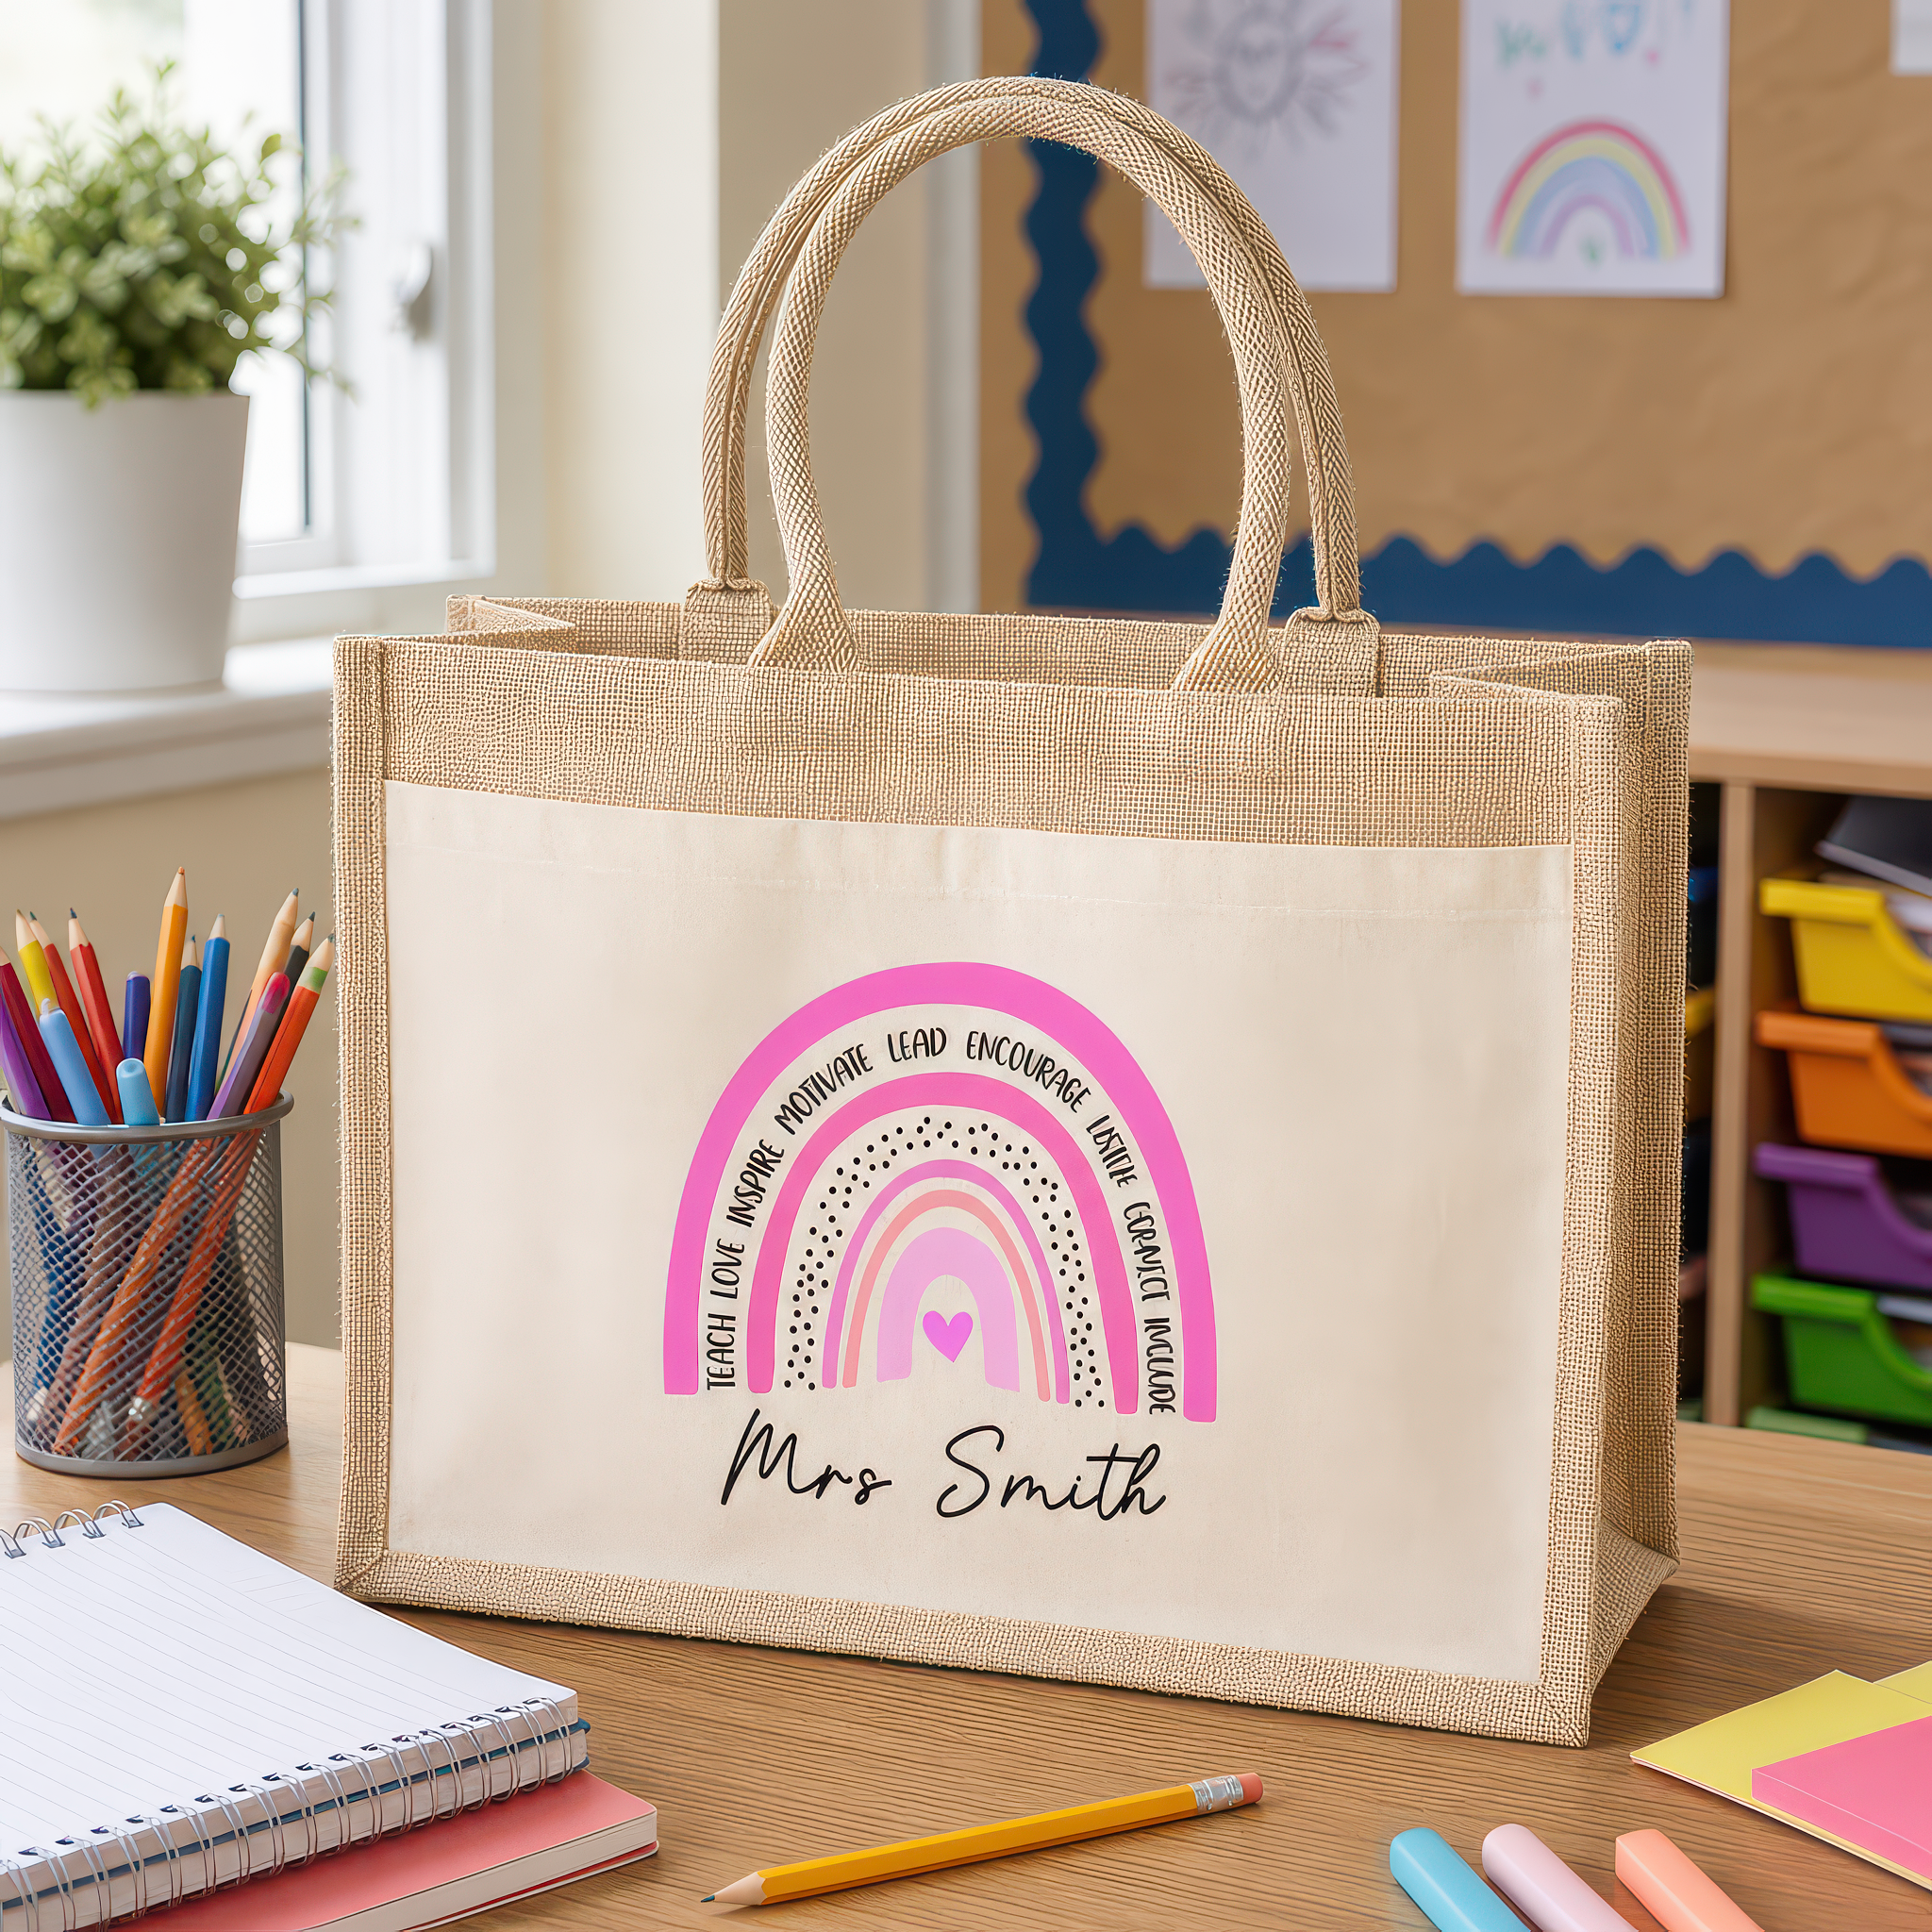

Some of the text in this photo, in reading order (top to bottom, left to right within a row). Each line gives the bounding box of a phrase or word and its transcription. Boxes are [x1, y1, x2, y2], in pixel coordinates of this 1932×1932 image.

[887, 1027, 947, 1063] LEAD
[966, 1030, 1091, 1114] ENCOURAGE
[774, 1043, 874, 1136] MOTIVATE
[726, 1139, 785, 1228] INSPIRE
[709, 1238, 744, 1300] LOVE
[707, 1312, 737, 1391] TEACH
[720, 1407, 1167, 1522] Mrs Smith
